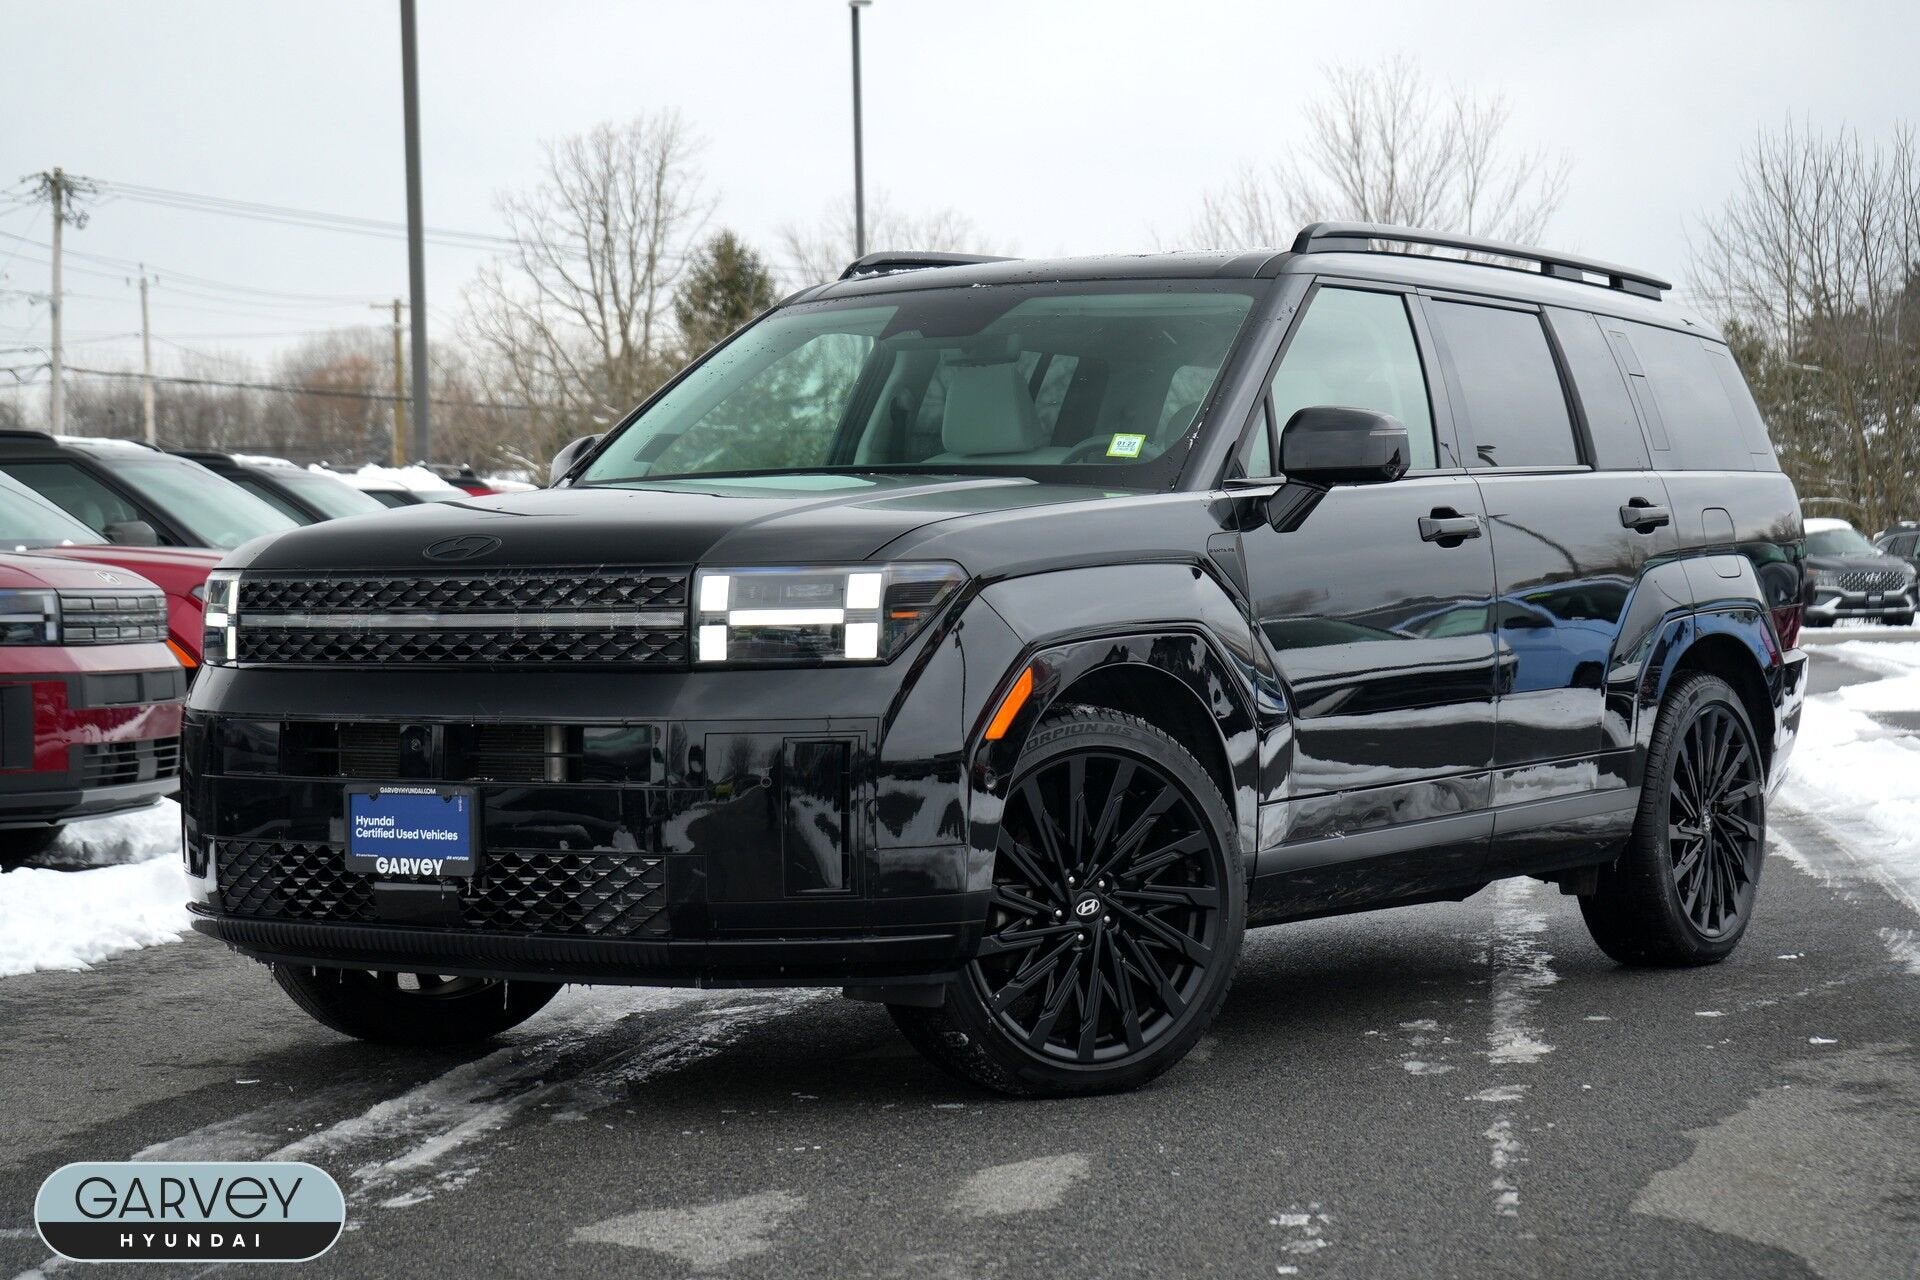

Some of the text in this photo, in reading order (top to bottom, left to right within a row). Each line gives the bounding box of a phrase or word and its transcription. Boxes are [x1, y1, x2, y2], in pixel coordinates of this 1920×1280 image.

[1026, 722, 1099, 751] ORPION
[355, 815, 395, 828] Hyundai
[355, 827, 458, 841] Certified Used Vehicles
[375, 856, 444, 876] GARVEY
